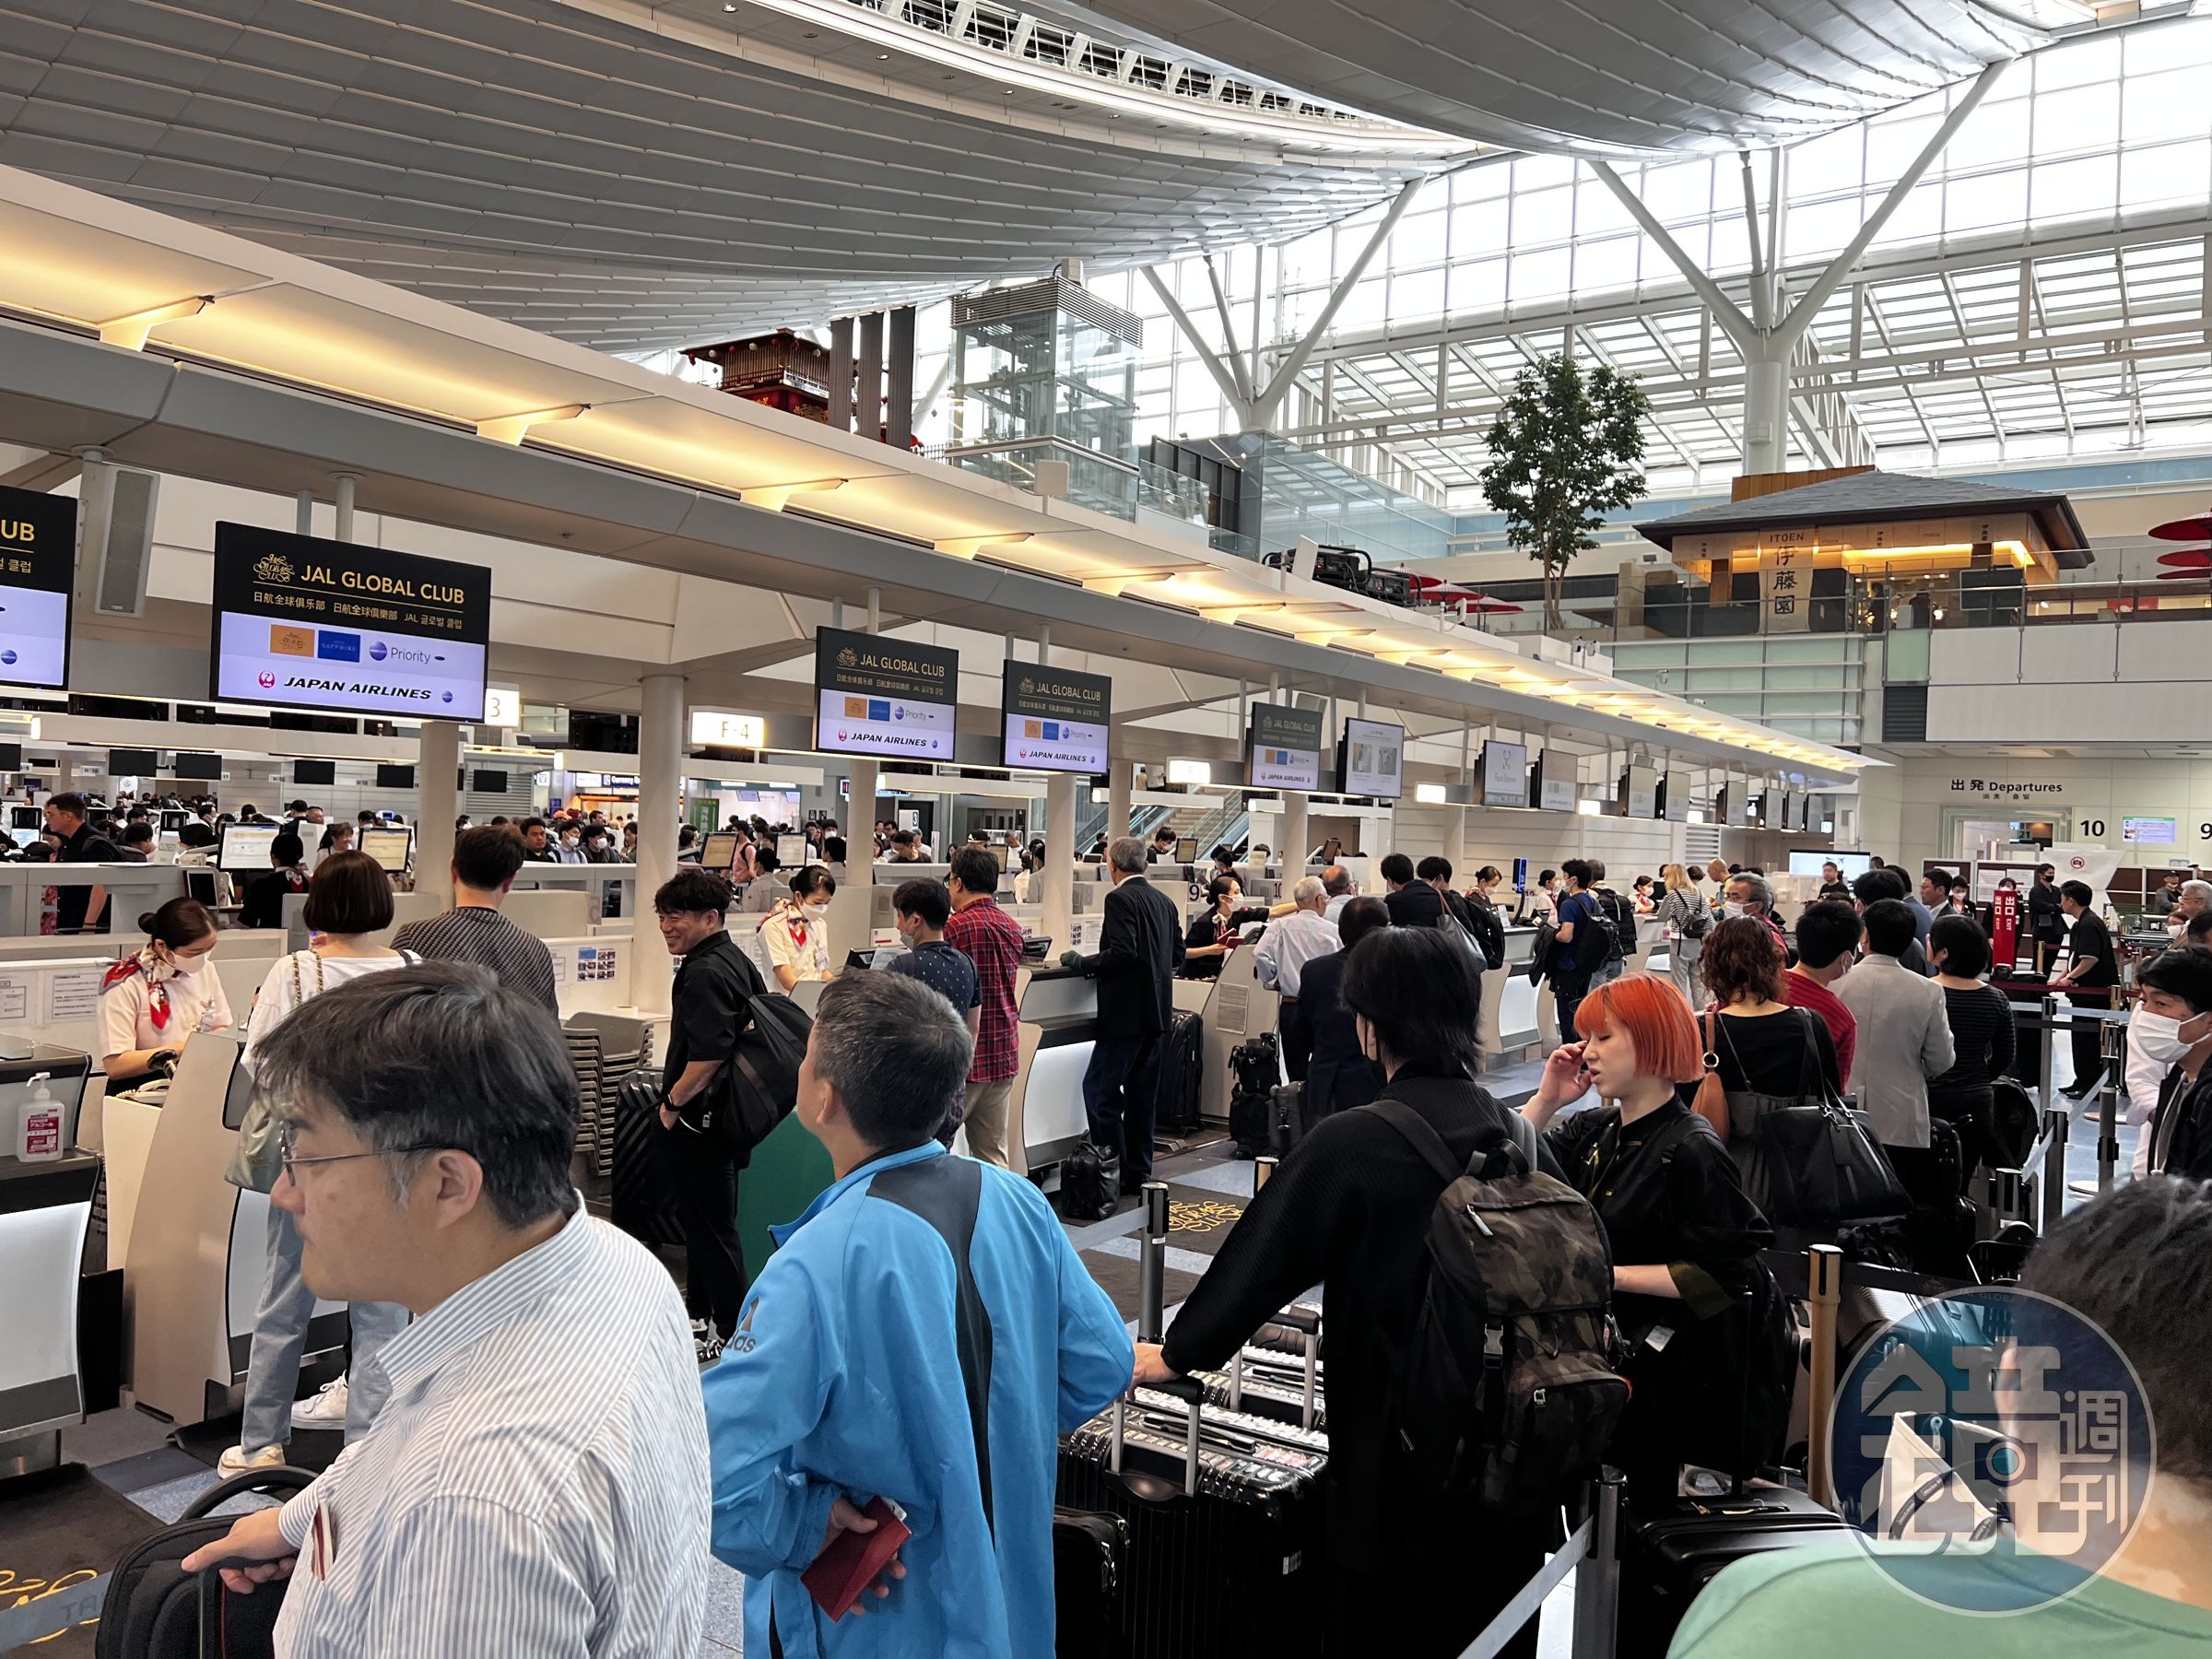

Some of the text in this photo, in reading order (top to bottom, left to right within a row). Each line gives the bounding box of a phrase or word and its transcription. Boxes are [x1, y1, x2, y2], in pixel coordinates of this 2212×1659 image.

[1770, 533, 1805, 543] ITOEN
[300, 565, 465, 605] JAL GLOBAL CLUB
[1773, 546, 1798, 615] 伊藤園
[404, 613, 418, 623] JAL
[391, 647, 431, 665] Priority
[860, 653, 878, 667] JAL
[880, 656, 919, 674] GLOBAL
[922, 664, 945, 677] CLUB
[284, 677, 432, 700] JAPAN AIRLINES
[1036, 683, 1050, 694] JAL
[1052, 685, 1081, 699] GLOBAL
[1082, 689, 1101, 700] CLUB
[490, 698, 500, 717] 3
[906, 709, 927, 721] Priority
[851, 733, 927, 747] JAPAN AIRLINES
[1030, 750, 1087, 762] JAPAN AIRLINES
[611, 776, 633, 785] Currency
[1951, 779, 2063, 794] 出発 Departures
[2080, 819, 2105, 837] 10
[2200, 823, 2212, 840] 9
[1189, 884, 1200, 901] 9
[1994, 896, 2002, 915] 出口
[2005, 896, 2016, 915] 出口
